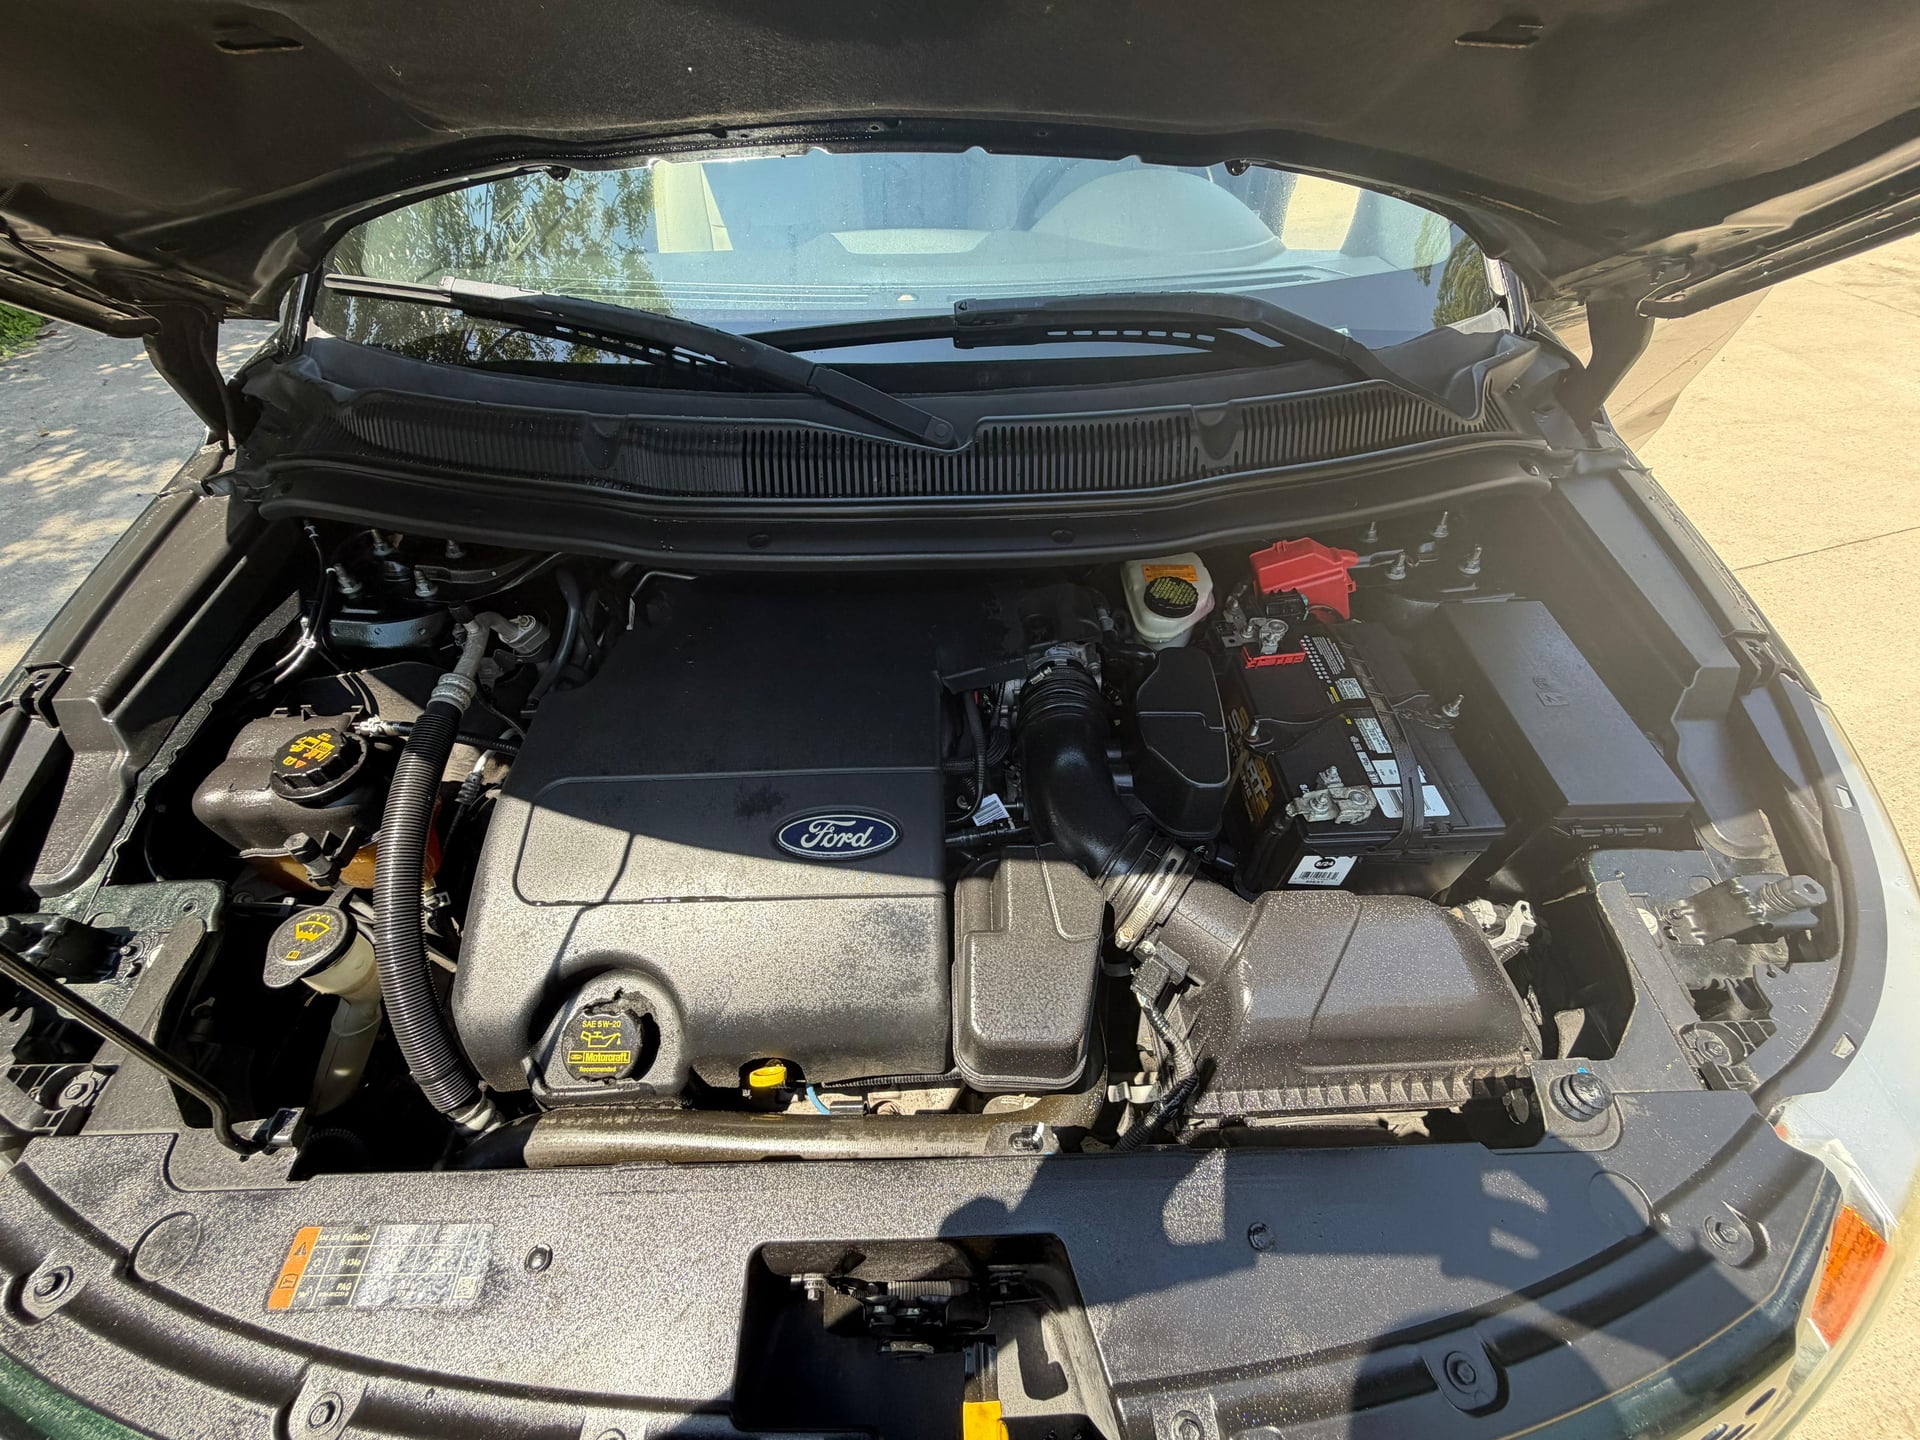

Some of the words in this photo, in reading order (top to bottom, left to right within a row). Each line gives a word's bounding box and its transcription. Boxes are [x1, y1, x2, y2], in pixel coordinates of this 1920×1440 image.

[800, 819, 874, 848] Ford
[582, 1020, 597, 1028] SAE
[597, 1020, 621, 1028] 5W-20
[585, 1052, 629, 1062] Motorcraft
[336, 1282, 352, 1290] PAG
